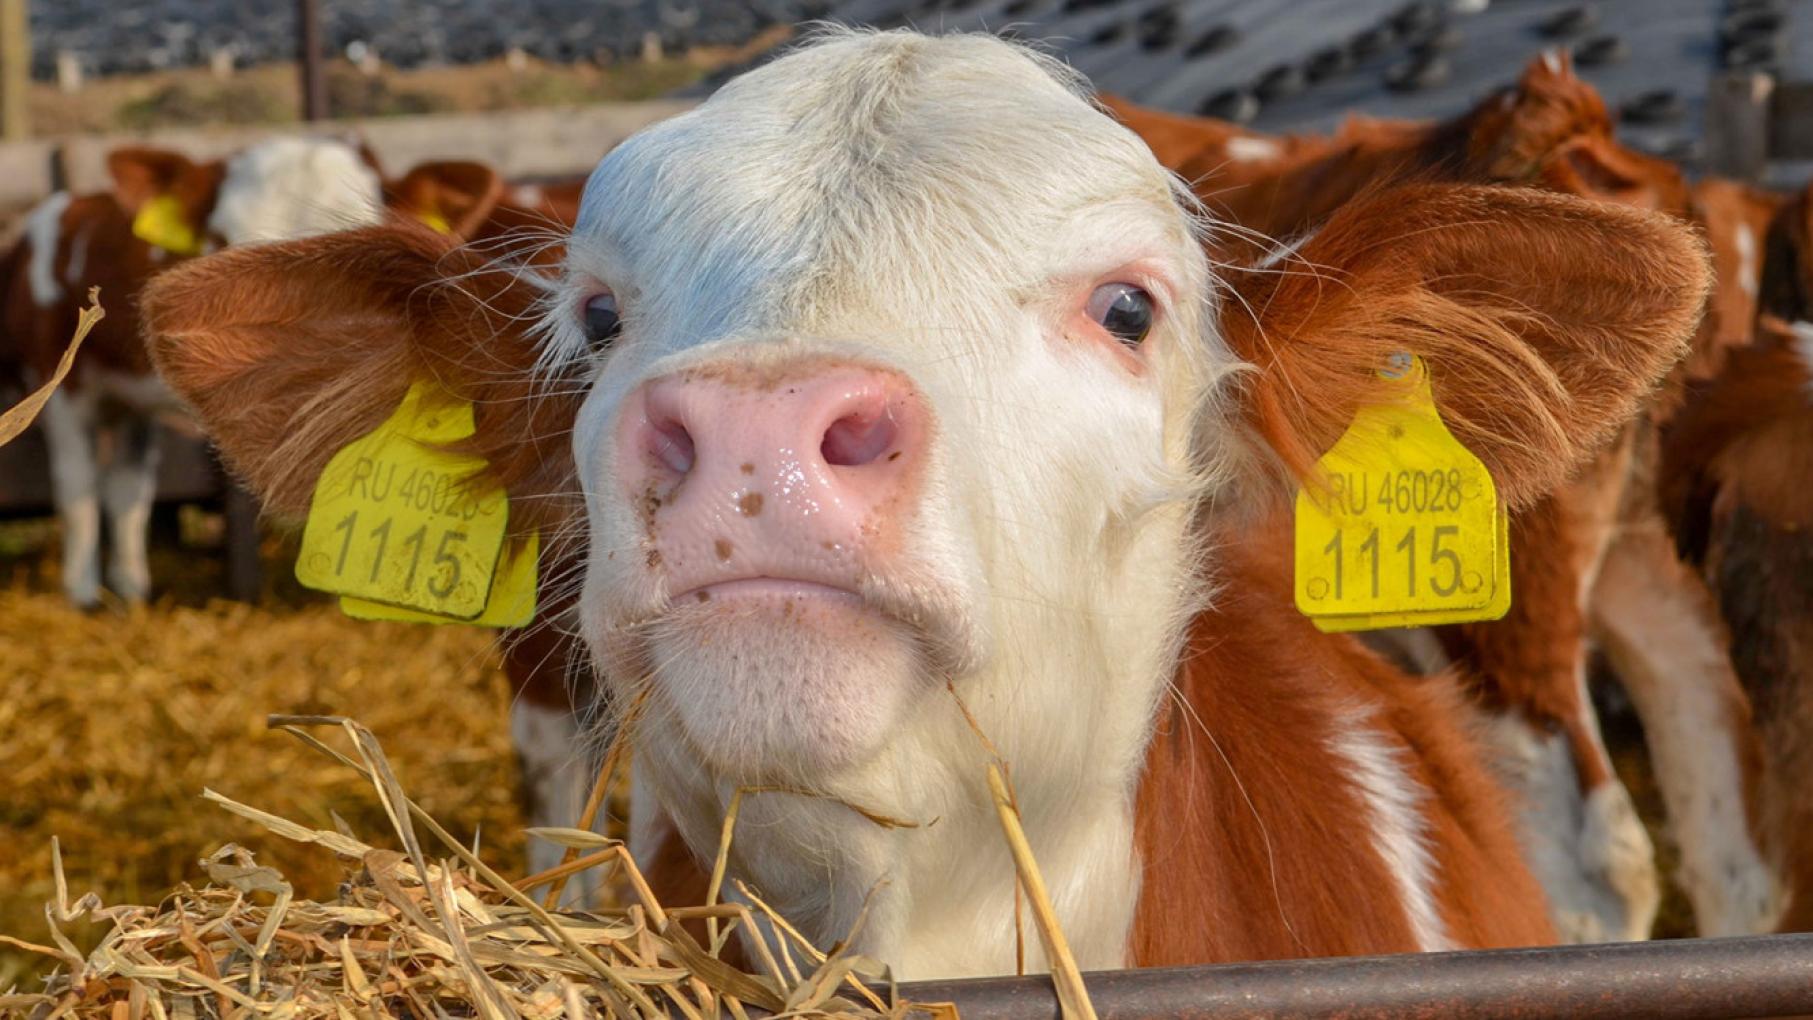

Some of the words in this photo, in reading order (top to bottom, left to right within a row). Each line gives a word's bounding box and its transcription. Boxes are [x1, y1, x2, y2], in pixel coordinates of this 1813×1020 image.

[349, 457, 396, 501] RU
[1326, 471, 1367, 516] RU
[1377, 468, 1461, 514] 46028
[335, 510, 468, 598] 1115
[1323, 525, 1462, 600] 1115
